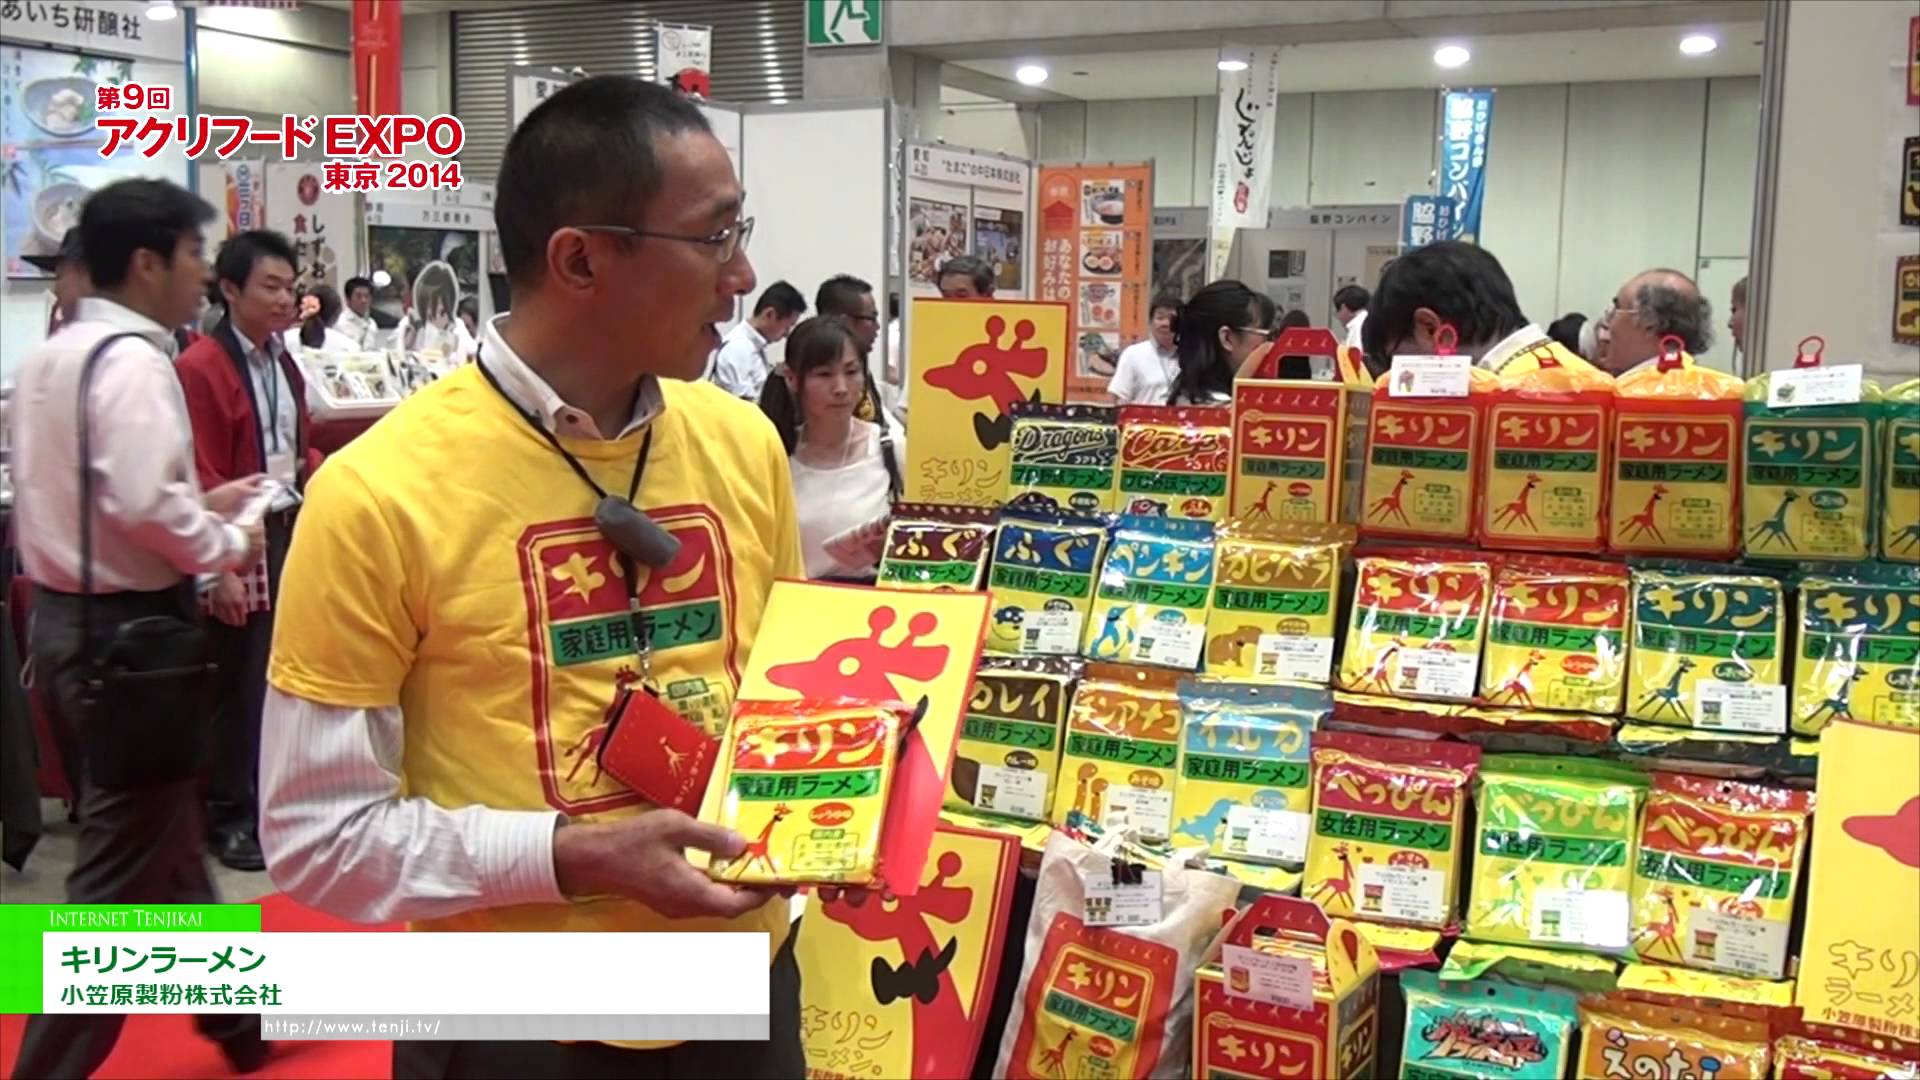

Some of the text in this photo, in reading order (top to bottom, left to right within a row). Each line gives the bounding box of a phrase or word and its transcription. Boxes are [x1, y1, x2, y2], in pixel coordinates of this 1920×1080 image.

[1012, 427, 1107, 459] Dragons
[1123, 427, 1220, 463] Carp
[1249, 425, 1321, 452] キリン
[1376, 414, 1466, 446] キリン
[1500, 415, 1595, 447] キリン
[1622, 424, 1724, 456] キリン
[1751, 430, 1858, 462] キリン
[920, 456, 1002, 489] キリン
[1374, 449, 1466, 470] 家庭用ラーメン
[1497, 452, 1594, 472] 家庭用ラーメン
[1620, 462, 1724, 482] 家庭用ラーメン
[1751, 466, 1859, 486] 家庭用ラーメン
[895, 528, 977, 559] ふぐ
[1003, 531, 1090, 568] ふぐ
[1219, 590, 1326, 612] 家庭用ラーメン
[1366, 572, 1478, 614] キリン
[1500, 583, 1619, 623] キリン
[1643, 585, 1773, 628] キリン
[969, 680, 1051, 719] カレイ
[744, 722, 880, 766] キリン
[1071, 735, 1177, 767] 家庭用ラーメン
[734, 772, 878, 799] 家庭用ラーメン
[1187, 756, 1306, 786] 家庭用ラーメン
[1327, 770, 1453, 818] べっぴん
[1320, 810, 1449, 849] 女性用ラーメン
[1647, 813, 1794, 864] べっぴん
[1066, 959, 1142, 1009] キリン
[800, 1004, 894, 1051] キリン
[1216, 1033, 1308, 1078] キリン
